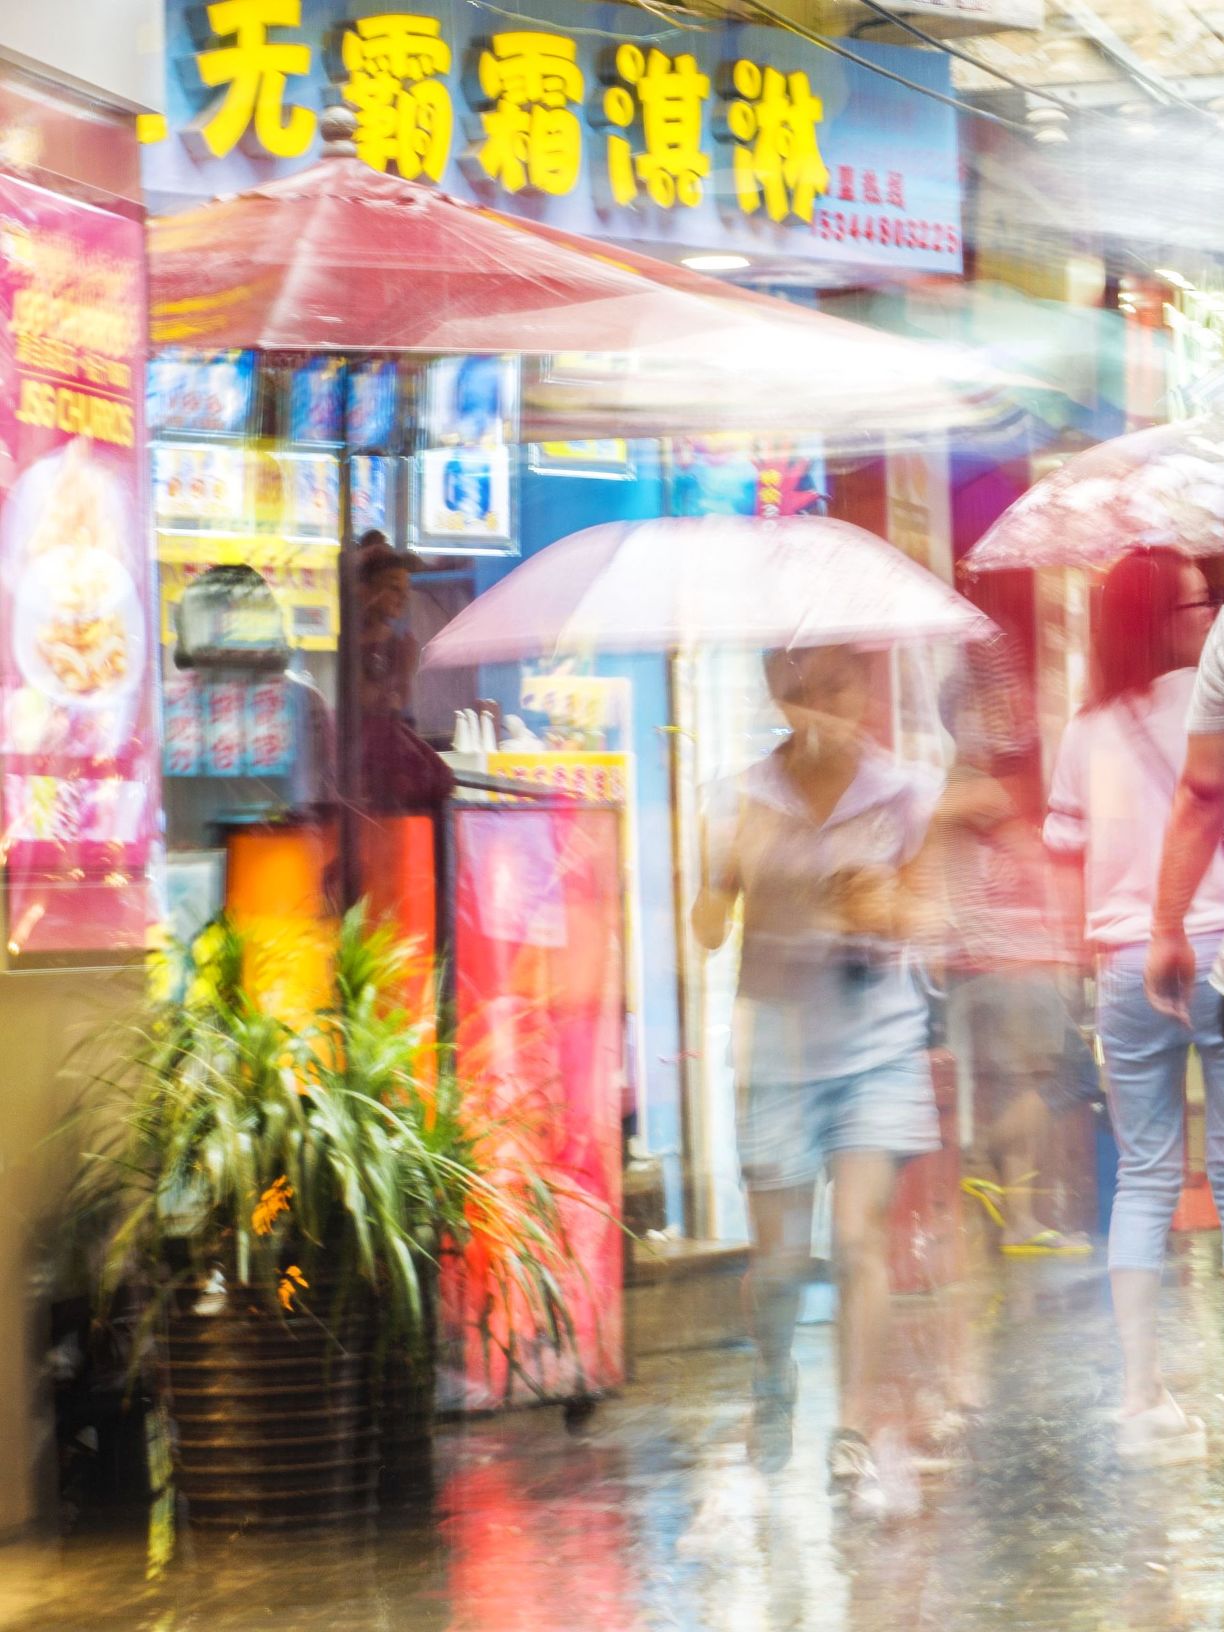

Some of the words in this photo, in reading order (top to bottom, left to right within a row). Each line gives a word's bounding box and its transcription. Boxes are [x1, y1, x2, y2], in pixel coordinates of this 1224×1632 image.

[135, 0, 829, 222] 无霸霜淇淋
